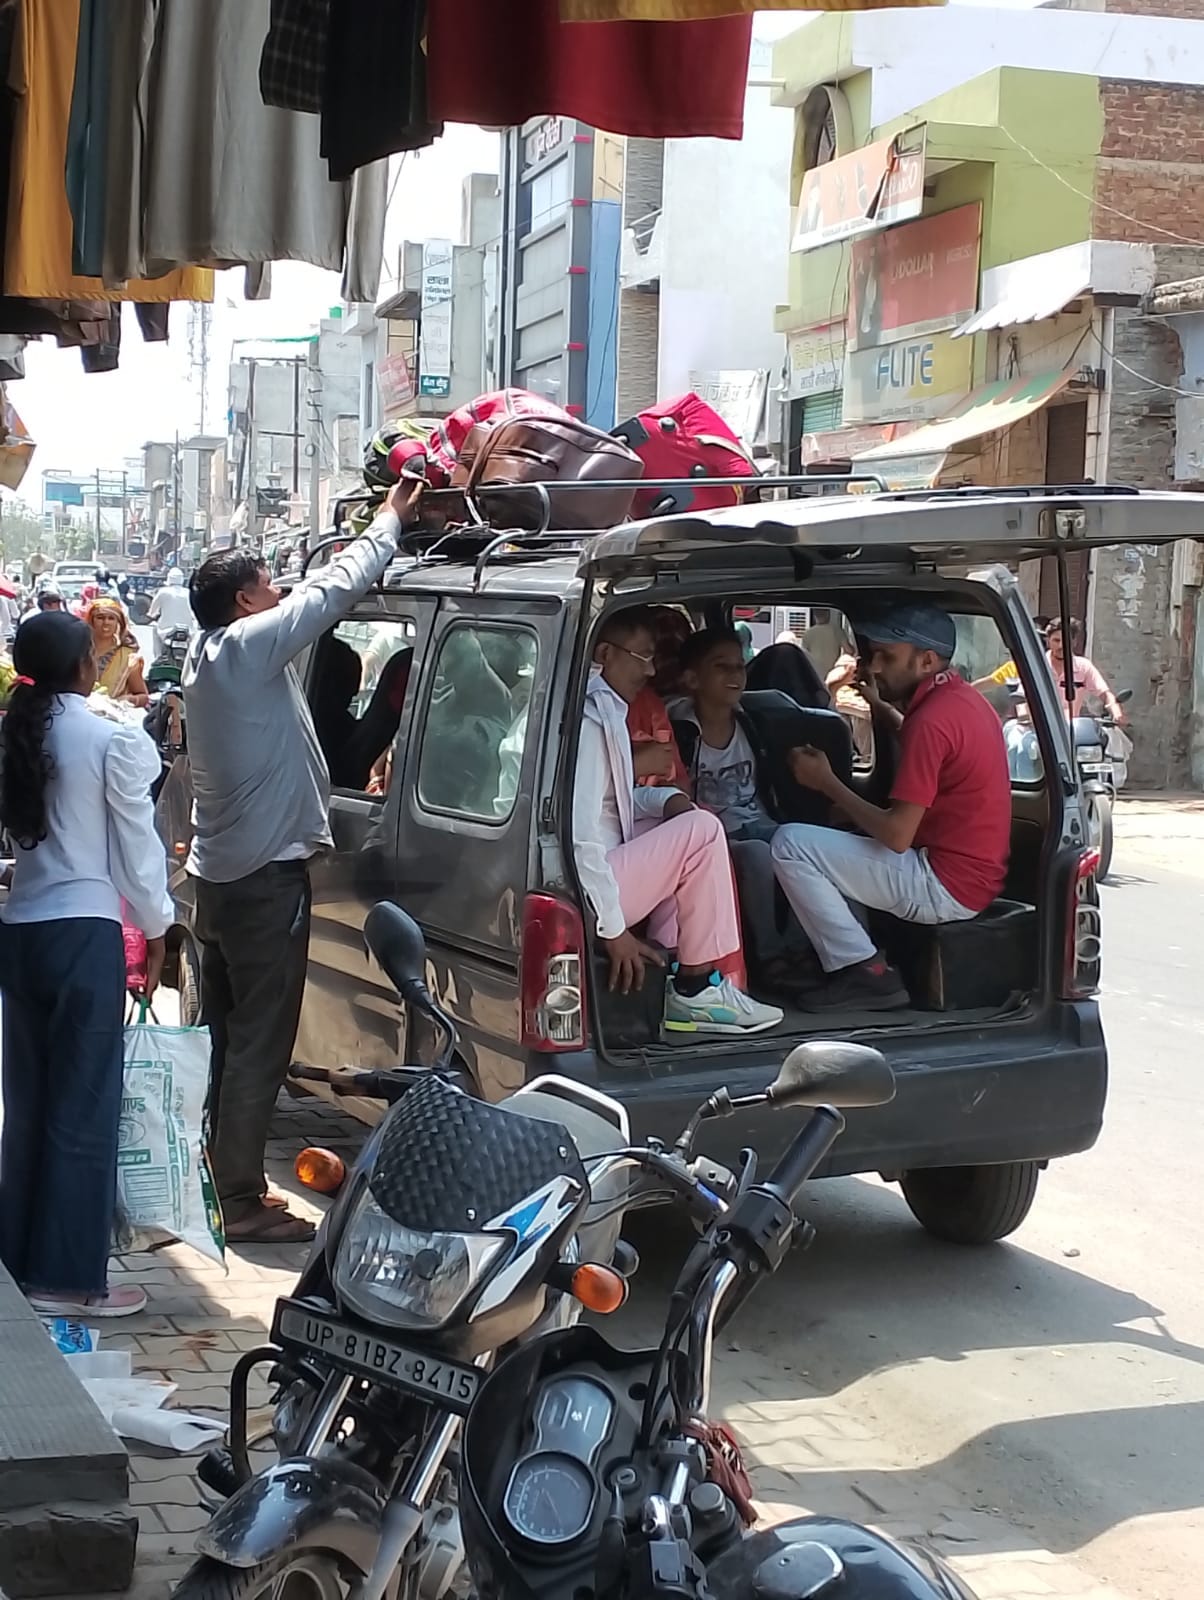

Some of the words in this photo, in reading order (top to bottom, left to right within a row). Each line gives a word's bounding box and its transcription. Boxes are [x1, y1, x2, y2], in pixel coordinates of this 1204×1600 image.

[306, 1319, 334, 1347] UP
[344, 1335, 402, 1376] 81BZ
[412, 1360, 474, 1399] 8415
